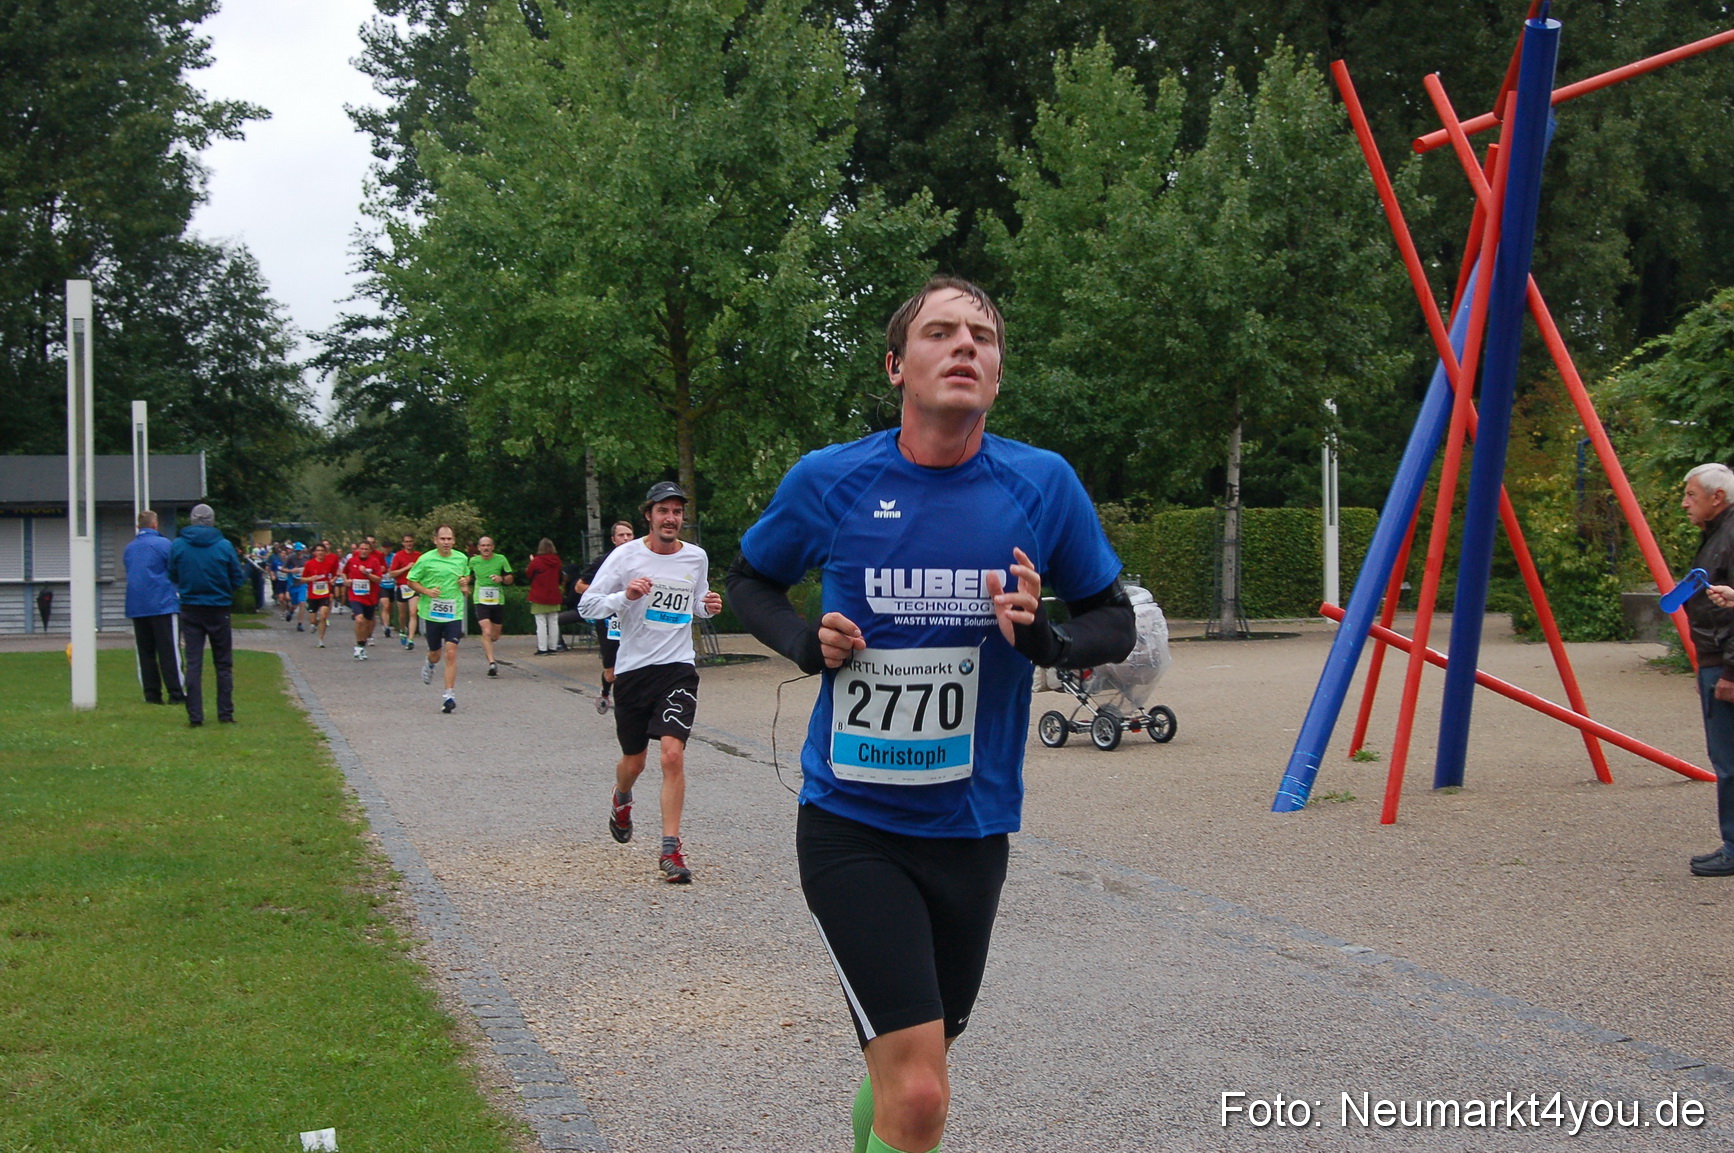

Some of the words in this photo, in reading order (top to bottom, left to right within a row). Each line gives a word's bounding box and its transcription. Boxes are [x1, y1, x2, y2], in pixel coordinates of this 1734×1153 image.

[873, 510, 901, 519] erima
[652, 591, 690, 611] 2401
[894, 601, 997, 612] TECHNOLOG
[894, 616, 926, 625] WASTE
[928, 616, 962, 626] WATER
[883, 662, 953, 676] Neumarkt
[847, 679, 964, 732] 2770
[858, 743, 946, 769] Christoph
